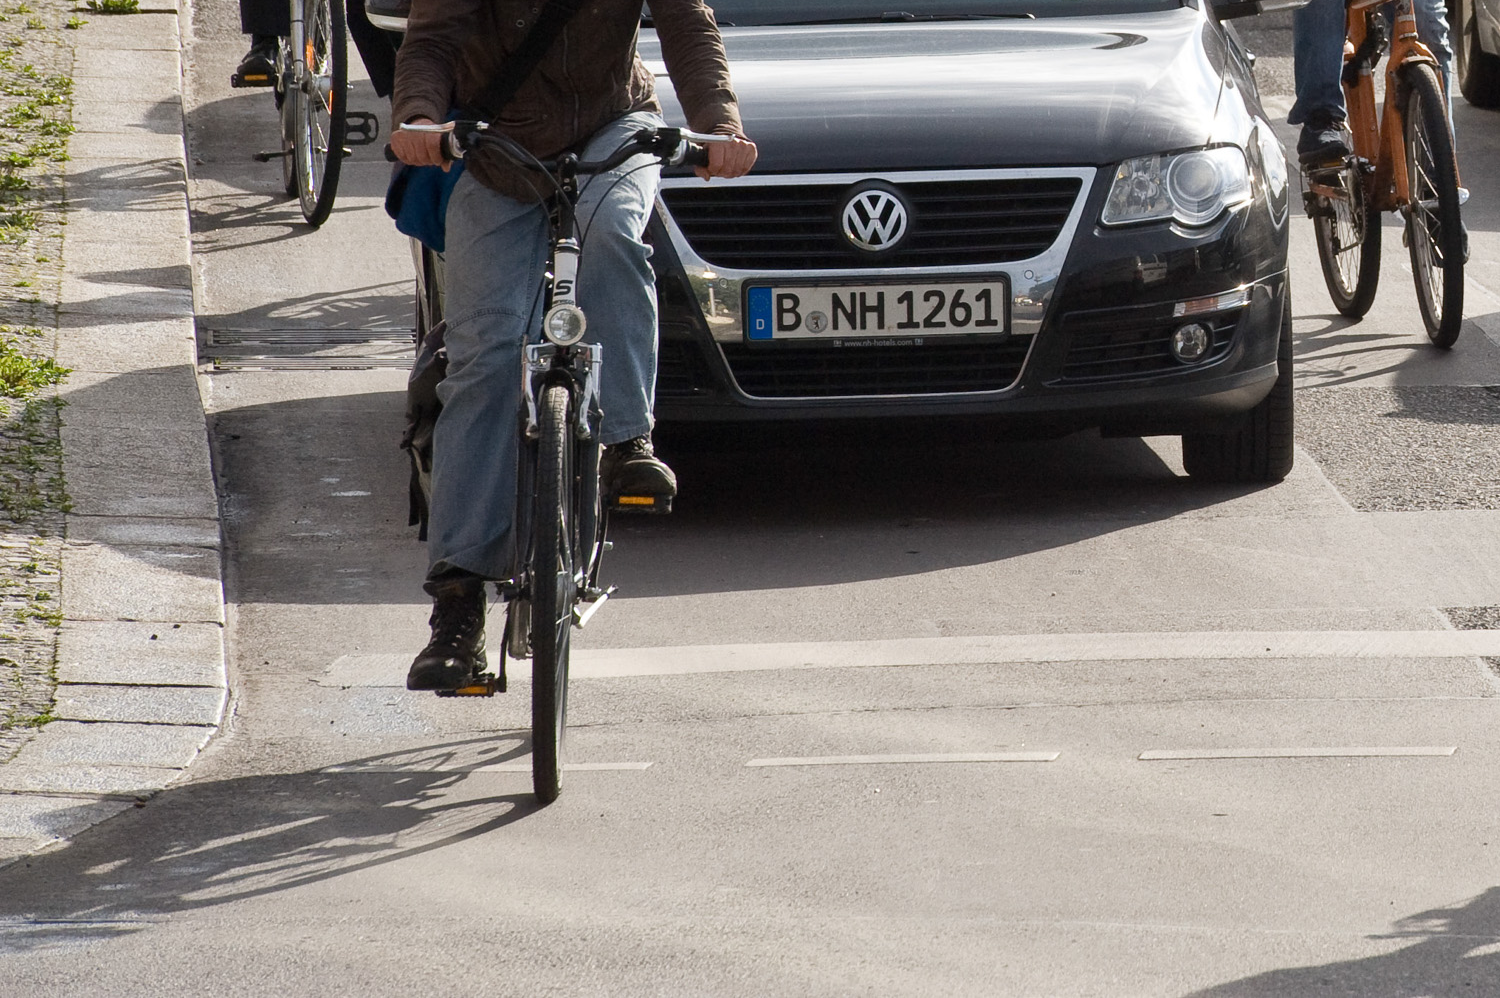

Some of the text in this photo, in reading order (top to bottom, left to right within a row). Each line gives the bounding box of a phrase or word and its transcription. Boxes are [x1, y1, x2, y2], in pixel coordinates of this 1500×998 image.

[554, 280, 573, 296] S
[776, 288, 998, 332] B NH 1261
[756, 319, 765, 330] D
[844, 338, 913, 347] www.nh-hotels.com
